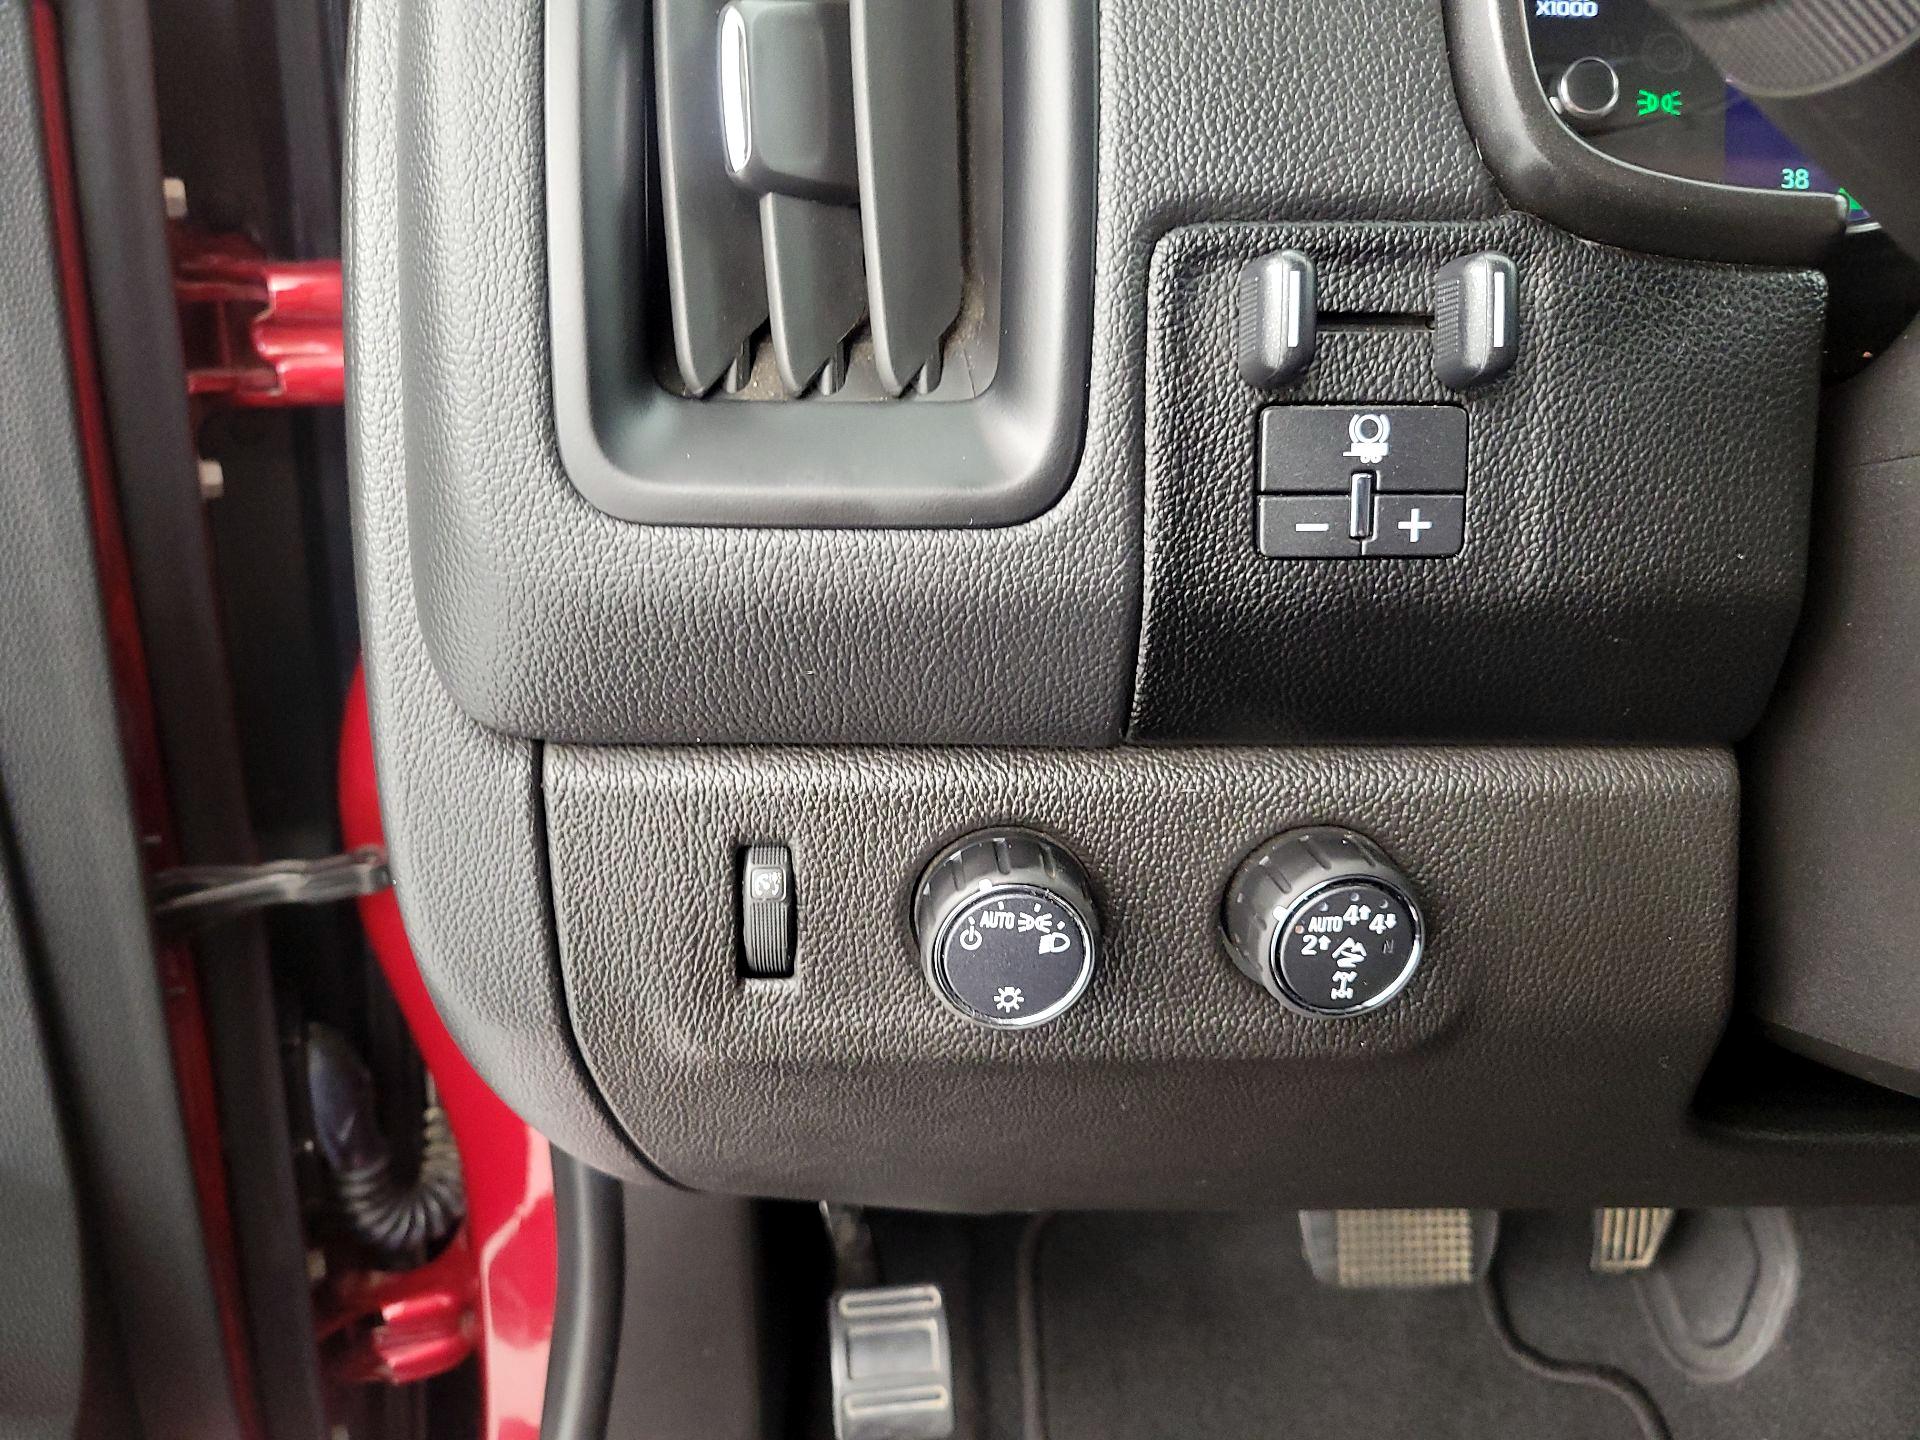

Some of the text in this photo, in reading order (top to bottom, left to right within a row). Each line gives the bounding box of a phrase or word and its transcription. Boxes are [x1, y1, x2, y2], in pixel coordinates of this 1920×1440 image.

[1781, 168, 1810, 190] 38
[979, 911, 1015, 930] AUTO
[1308, 915, 1343, 933] AUTO
[1342, 904, 1360, 926] 4
[1368, 913, 1387, 935] 4
[1301, 934, 1317, 956] 2
[1382, 938, 1394, 955] N
